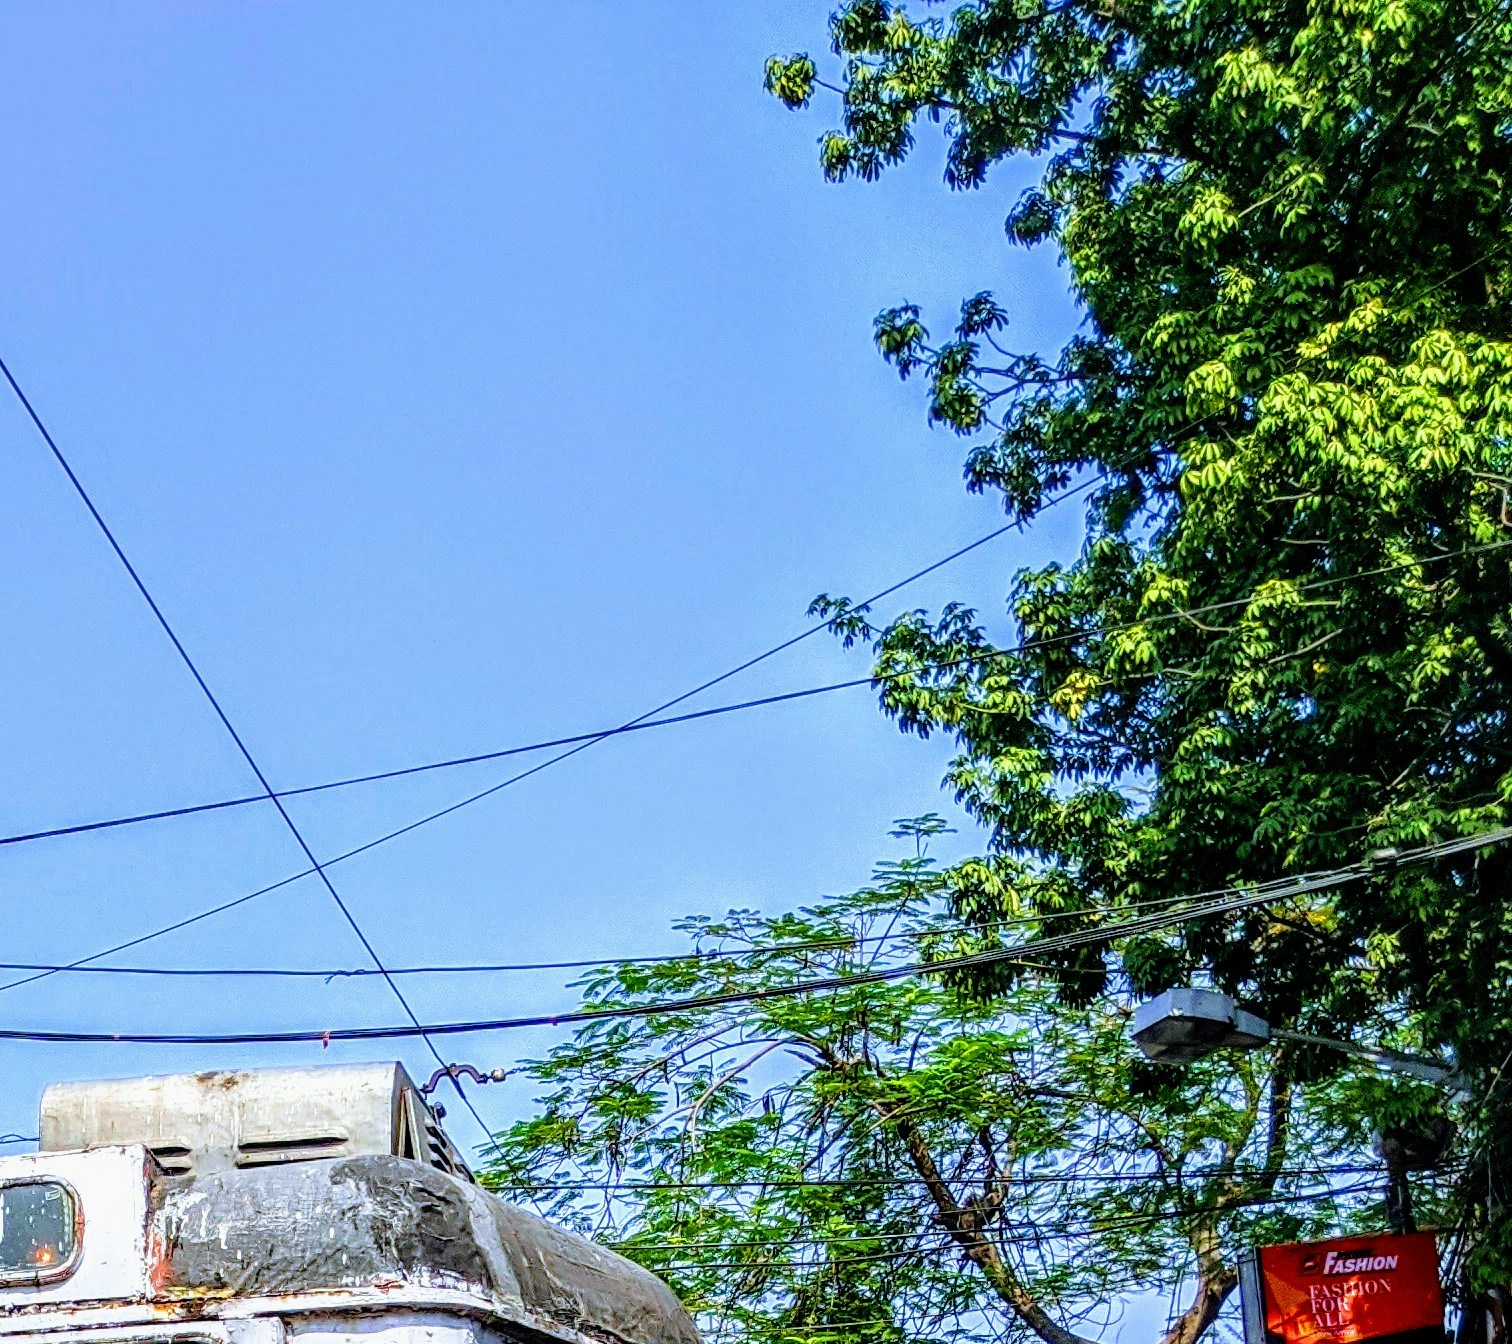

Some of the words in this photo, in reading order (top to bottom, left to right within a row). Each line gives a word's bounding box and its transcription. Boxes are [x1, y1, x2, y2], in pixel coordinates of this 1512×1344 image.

[1323, 1251, 1399, 1275] FASHION
[1309, 1278, 1392, 1299] FASHION
[1310, 1296, 1351, 1314] FOR
[1314, 1311, 1350, 1328] ALL
